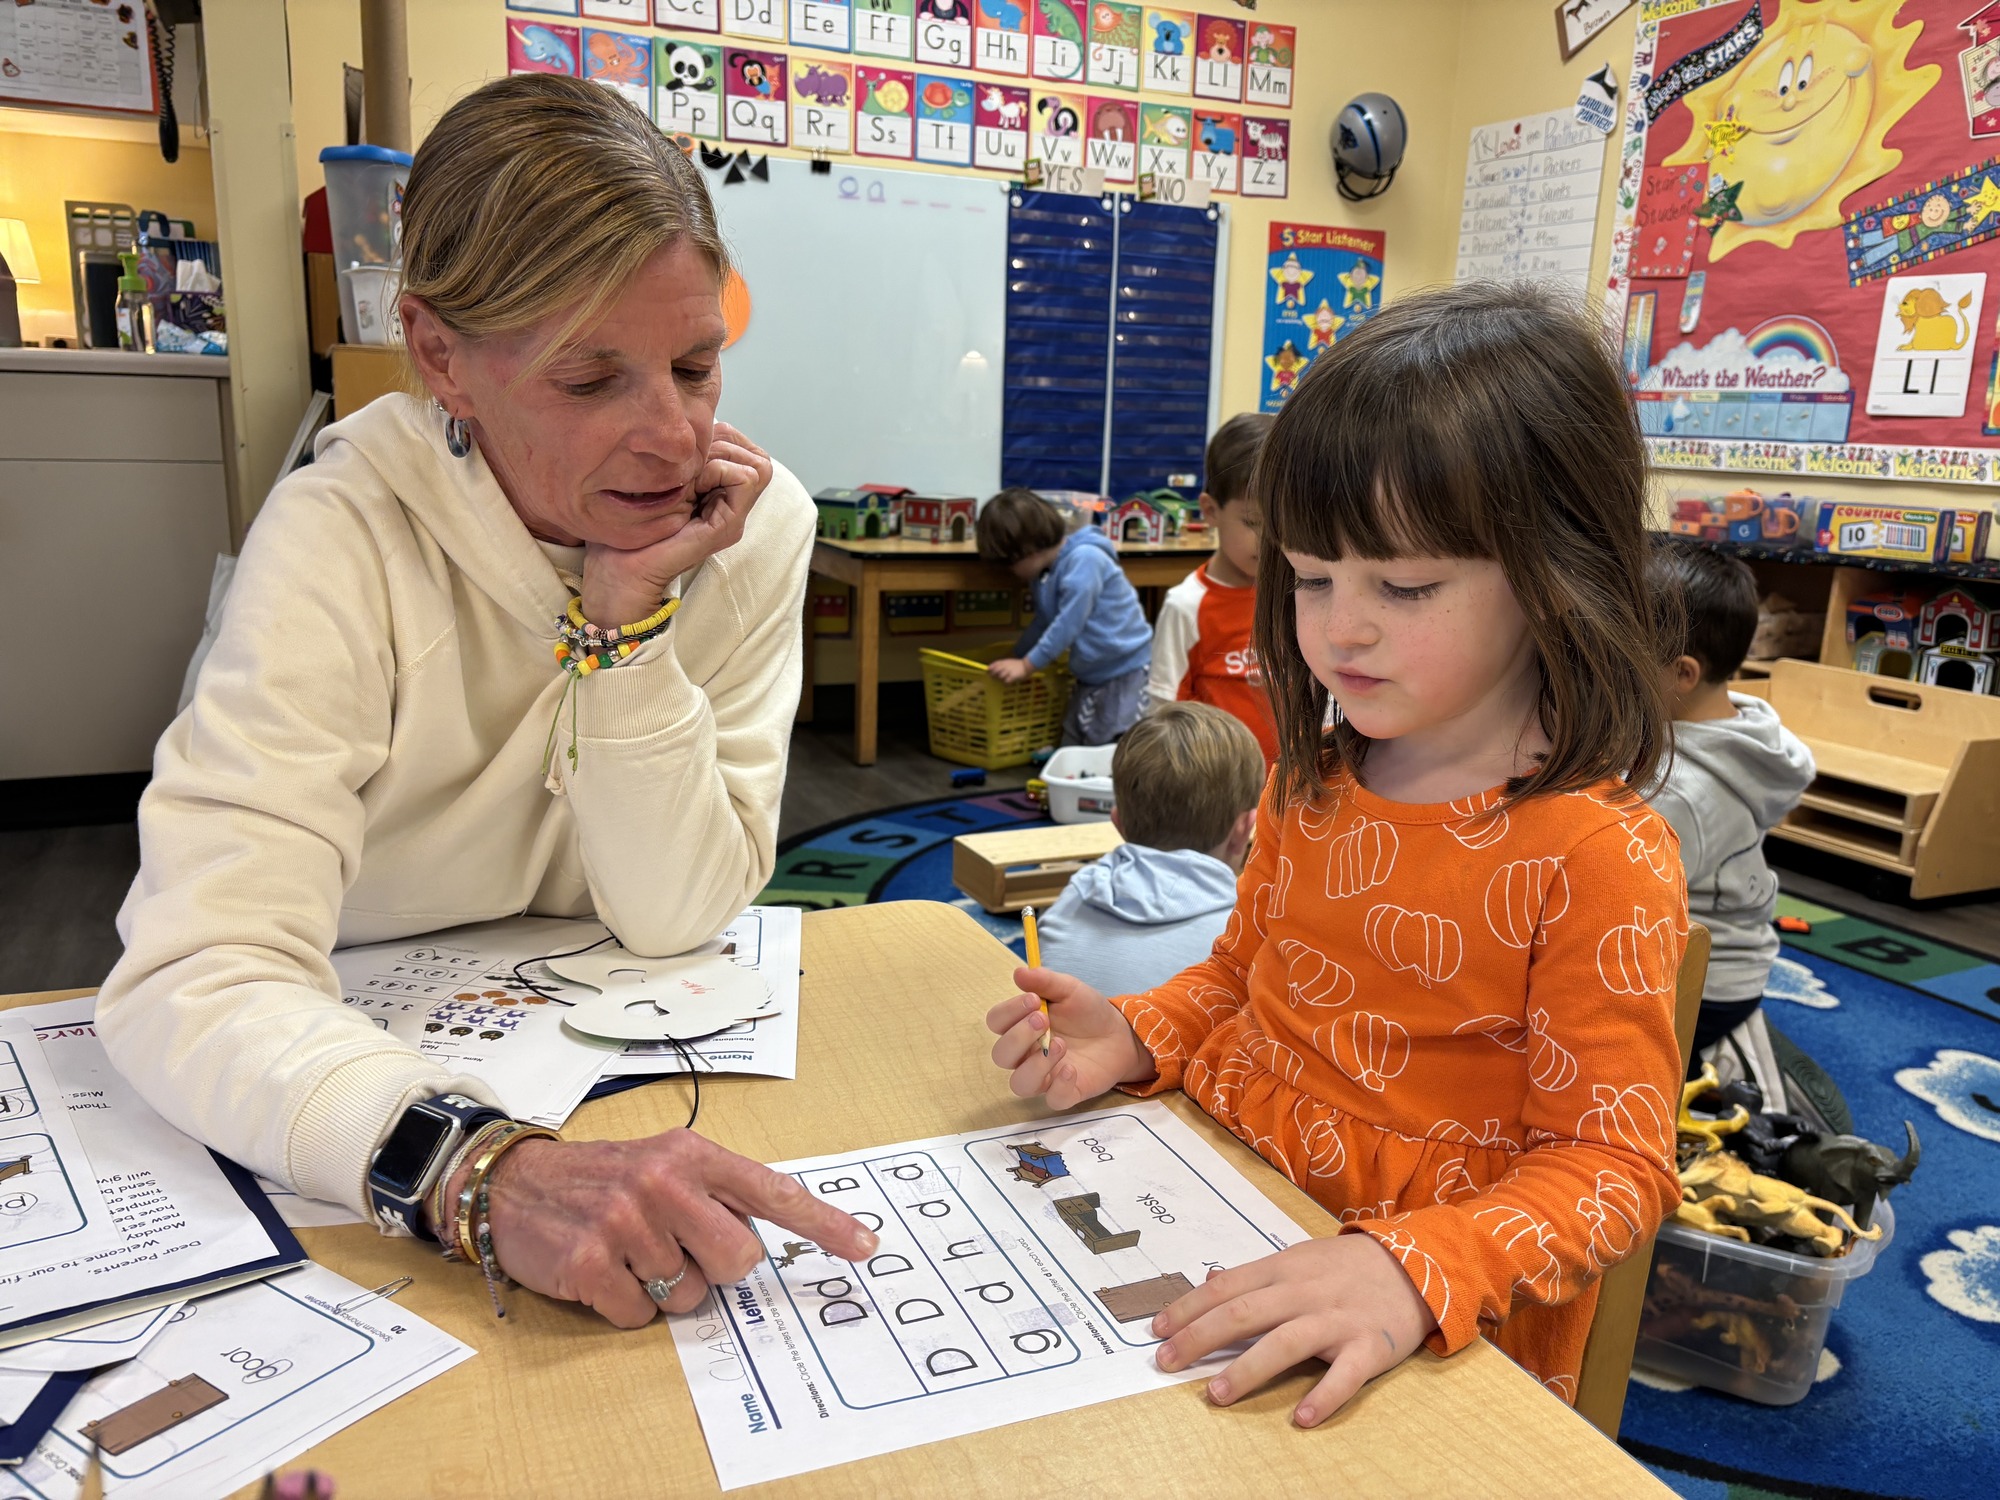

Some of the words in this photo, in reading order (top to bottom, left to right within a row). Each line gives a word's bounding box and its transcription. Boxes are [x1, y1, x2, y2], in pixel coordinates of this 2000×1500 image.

[804, 5, 834, 33] Ee
[870, 15, 896, 41] Ff
[924, 25, 962, 64] Gg
[986, 33, 1017, 61] Hh
[1051, 41, 1067, 67] Ii
[1103, 49, 1124, 85] Jj
[1154, 55, 1181, 82] Kk
[1649, 74, 1681, 110] Meet
[1681, 63, 1706, 84] the
[1704, 21, 1757, 69] STARS
[1250, 71, 1288, 95] Mm
[672, 93, 705, 133] Pp
[732, 105, 778, 141] Qq
[807, 109, 836, 136] Rr
[871, 117, 897, 144] Ss
[931, 124, 955, 150] Tt
[985, 131, 1016, 157] Uu
[1041, 138, 1072, 162] Vv
[1090, 141, 1131, 169] Ww
[1150, 148, 1177, 174] Xx
[1202, 155, 1228, 188] Yy
[1251, 160, 1277, 185] Zz
[1044, 163, 1084, 193] YES
[1156, 177, 1187, 203] NO
[1647, 175, 1680, 196] Star
[1640, 198, 1694, 227] Student
[1282, 228, 1295, 248] 5
[1297, 229, 1322, 245] Star
[1326, 232, 1376, 253] Listener
[1661, 366, 1709, 388] What's
[1714, 366, 1739, 387] the
[1744, 364, 1827, 388] Weather?
[1725, 450, 1796, 472] Welcome
[1806, 451, 1883, 476] Welcome
[1893, 454, 1980, 482] Welcome
[1837, 506, 1903, 521] COUNTING
[1848, 527, 1866, 543] 10
[786, 860, 870, 879] R
[848, 829, 918, 849] S
[914, 807, 977, 826] T
[1831, 936, 1929, 965] B
[68, 1103, 111, 1111] Thank
[1078, 1137, 1115, 1163] bed
[127, 1170, 151, 1181] will
[881, 1163, 924, 1181] d
[118, 1180, 156, 1193] Send
[128, 1188, 163, 1199] time
[818, 1177, 861, 1194] B
[139, 1204, 175, 1216] have
[151, 1212, 180, 1223] new
[906, 1199, 951, 1218] d
[1136, 1193, 1175, 1225] desk
[121, 1221, 146, 1232] set
[126, 1220, 186, 1241] Monday
[84, 1239, 160, 1263] Welcome
[162, 1240, 201, 1255] Dear
[1029, 1252, 1043, 1267] each
[28, 1266, 55, 1277] our
[61, 1261, 80, 1269] to
[867, 1254, 914, 1278] D
[758, 1281, 770, 1297] same
[964, 1281, 1014, 1303] d
[1049, 1278, 1065, 1293] letter
[1061, 1292, 1072, 1303] the
[734, 1286, 765, 1326] Letter
[803, 1276, 869, 1327] Dd
[895, 1298, 944, 1325] D
[1069, 1302, 1087, 1320] Circle
[363, 1324, 393, 1342] Spectrum
[391, 1325, 407, 1334] 20
[774, 1319, 786, 1331] that
[1083, 1320, 1114, 1355] Directions:
[784, 1331, 796, 1350] letters
[1009, 1328, 1062, 1354] g
[221, 1346, 279, 1378] door
[791, 1350, 801, 1362] the
[926, 1348, 978, 1377] D
[797, 1362, 810, 1381] Circle
[806, 1381, 829, 1419] Directions:
[741, 1393, 768, 1434] Name
